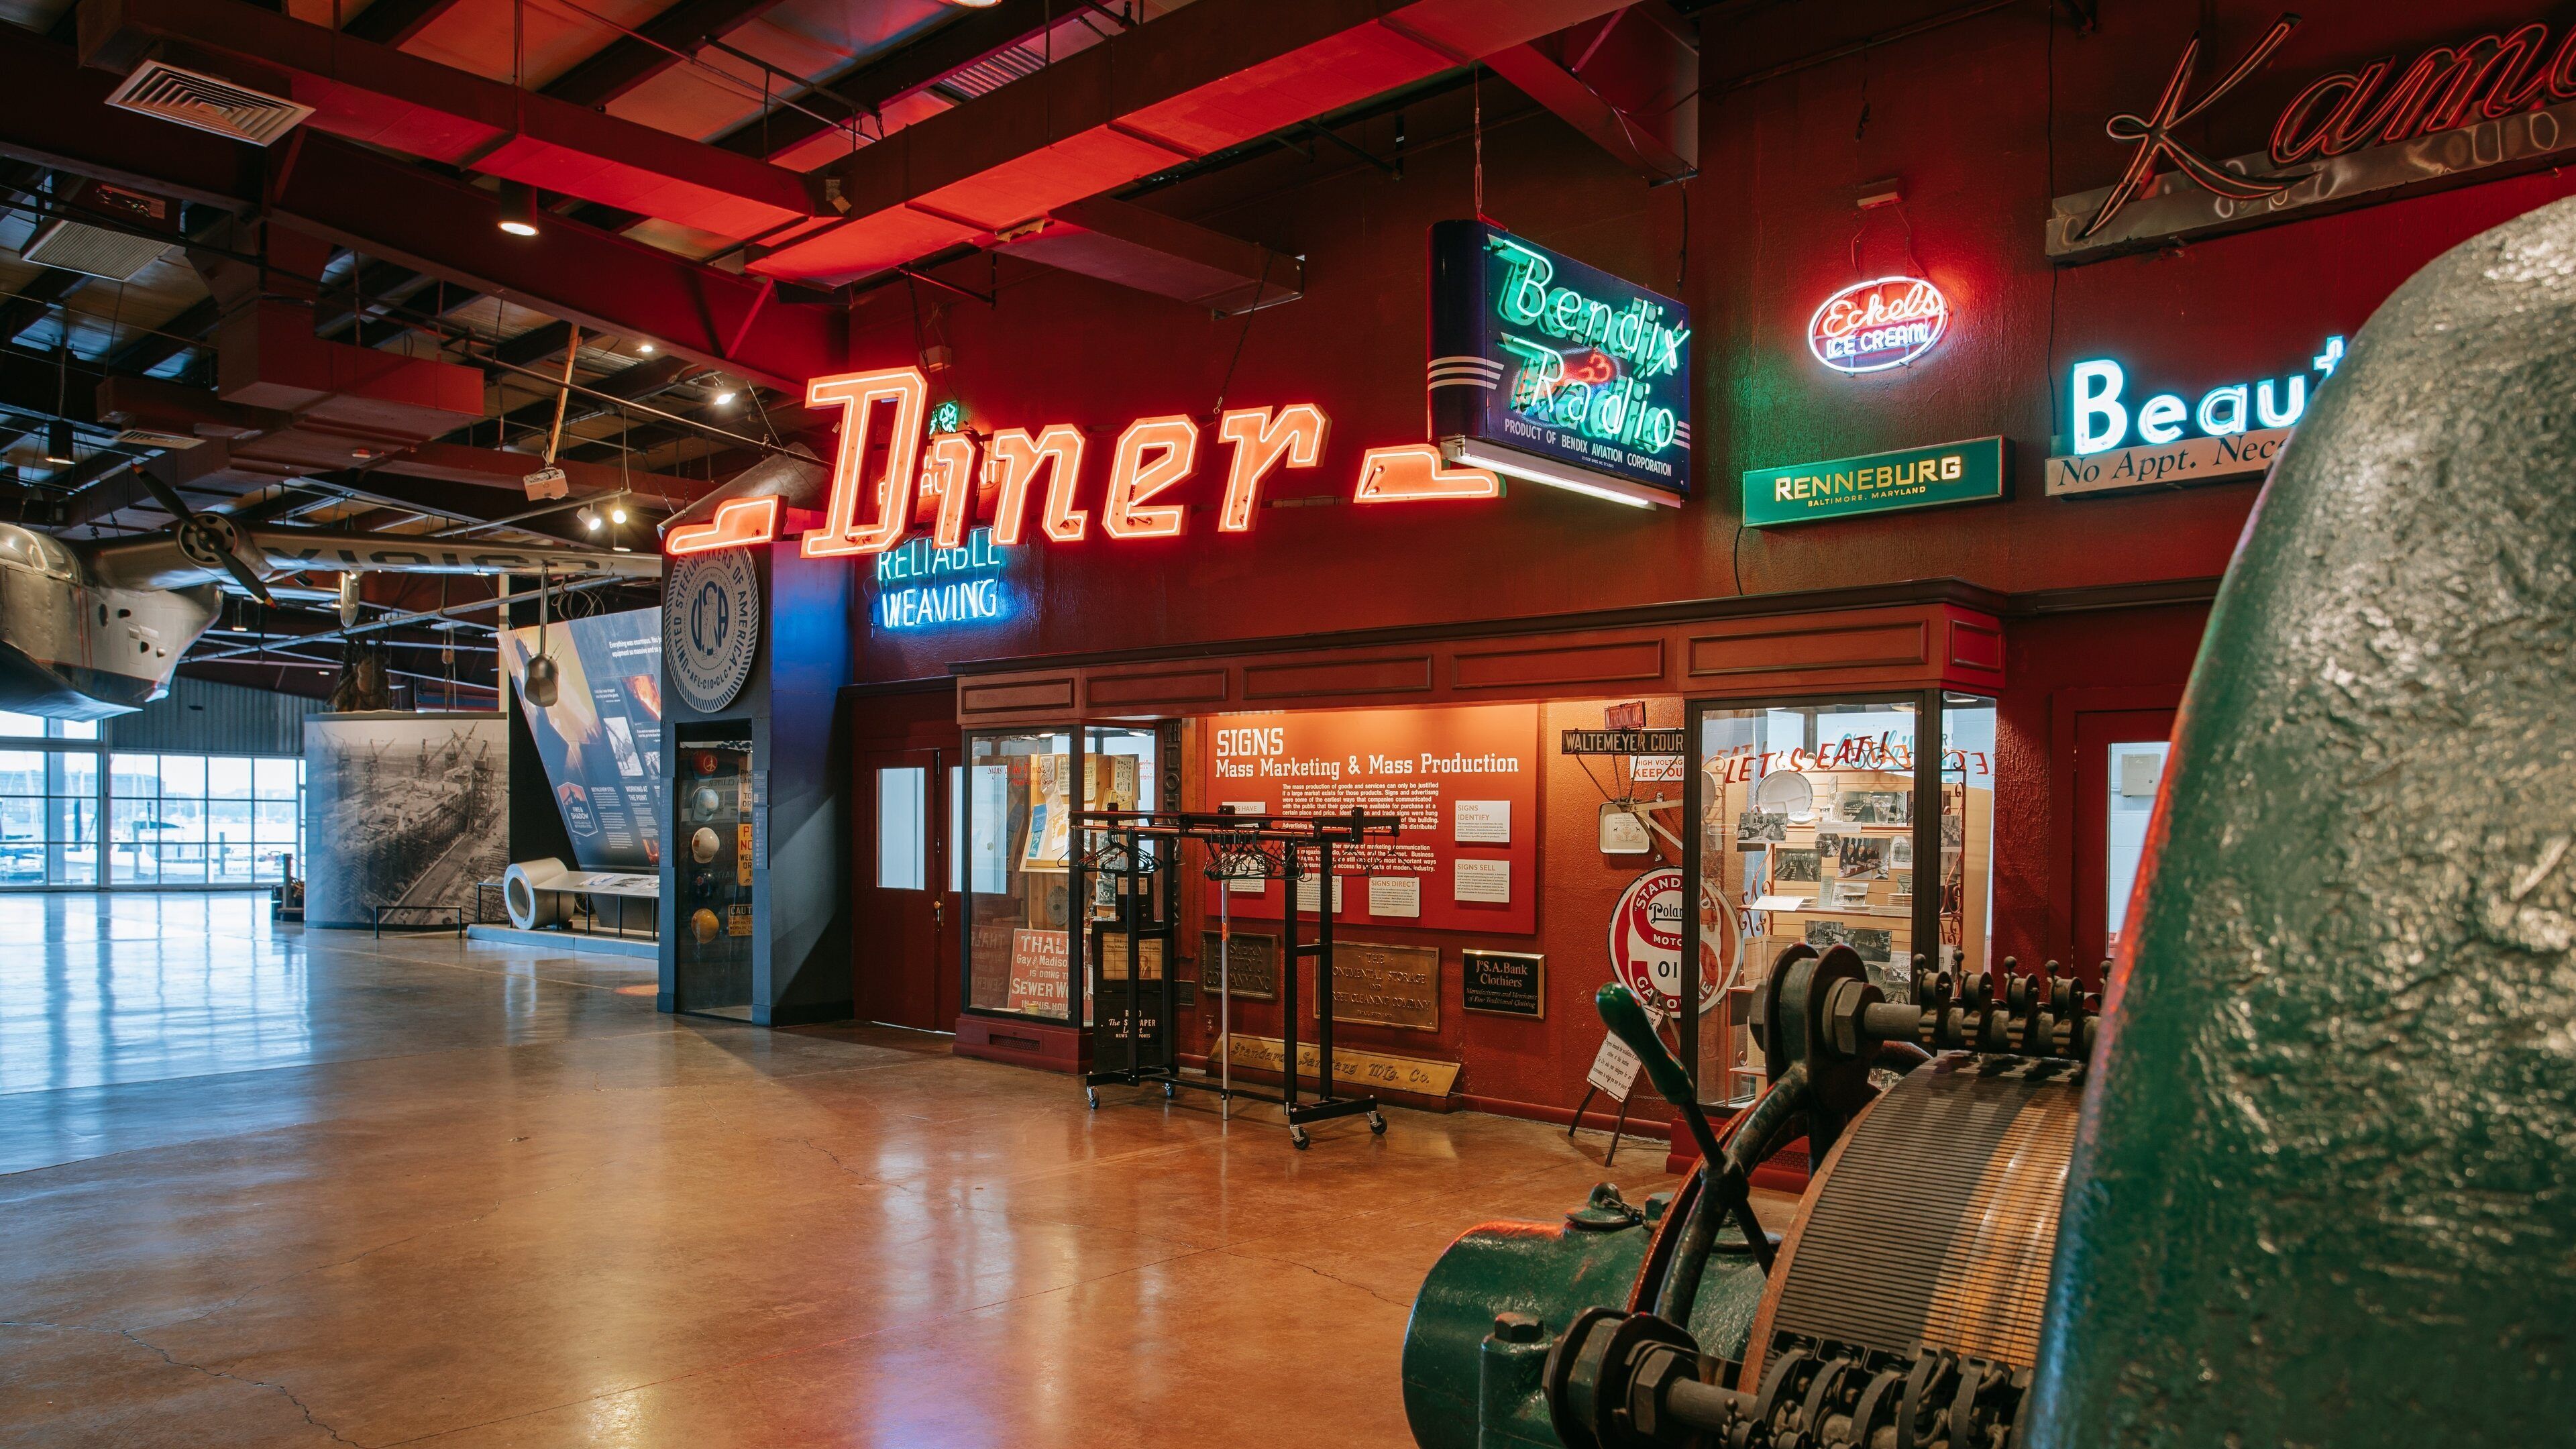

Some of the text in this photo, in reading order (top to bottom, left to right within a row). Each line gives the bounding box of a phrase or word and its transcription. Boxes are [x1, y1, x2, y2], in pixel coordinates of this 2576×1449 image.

[1486, 233, 1691, 380] Bendix
[1823, 282, 1939, 336] Eckels
[1826, 323, 1929, 359] ICE CREAM
[1497, 333, 1675, 454] Radio
[1505, 419, 1672, 477] PRODUCT OF BENDIX AVIATION CORPORATION
[800, 365, 1332, 559] Diner
[2057, 458, 2100, 486] No
[2112, 449, 2197, 482] Appt.
[1775, 456, 1962, 502] RENNEBURG
[1872, 486, 1926, 499] MARYLAND
[733, 566, 744, 586] OF
[882, 578, 997, 628] WEAVING
[729, 590, 749, 667] AMERICA
[609, 641, 627, 649] Everything
[612, 650, 629, 658] equipment
[674, 616, 690, 673] UNITED
[1217, 727, 1283, 757] SIGNS
[1566, 733, 1645, 751] WALTEMEYER
[1216, 752, 1519, 780] Mass Marketing & Mass Production
[1725, 746, 1803, 784] LET'S
[1817, 731, 1889, 769] EAT!
[1634, 768, 1662, 777] KEEP
[1016, 954, 1032, 967] Gay
[1366, 953, 1385, 965] THE
[1030, 969, 1037, 977] IS
[1039, 970, 1060, 979] DOING
[1332, 966, 1426, 984] ONUMENTAL STORAGE
[1480, 973, 1523, 988] Clothiers
[1012, 977, 1053, 998] SEWER
[1368, 983, 1381, 991] AND
[1351, 993, 1389, 1007] CLEANING
[1392, 997, 1432, 1010] COMPANY
[1486, 997, 1513, 1006] Traditional
[1109, 1018, 1120, 1026] The
[1409, 1067, 1430, 1085] Co.
